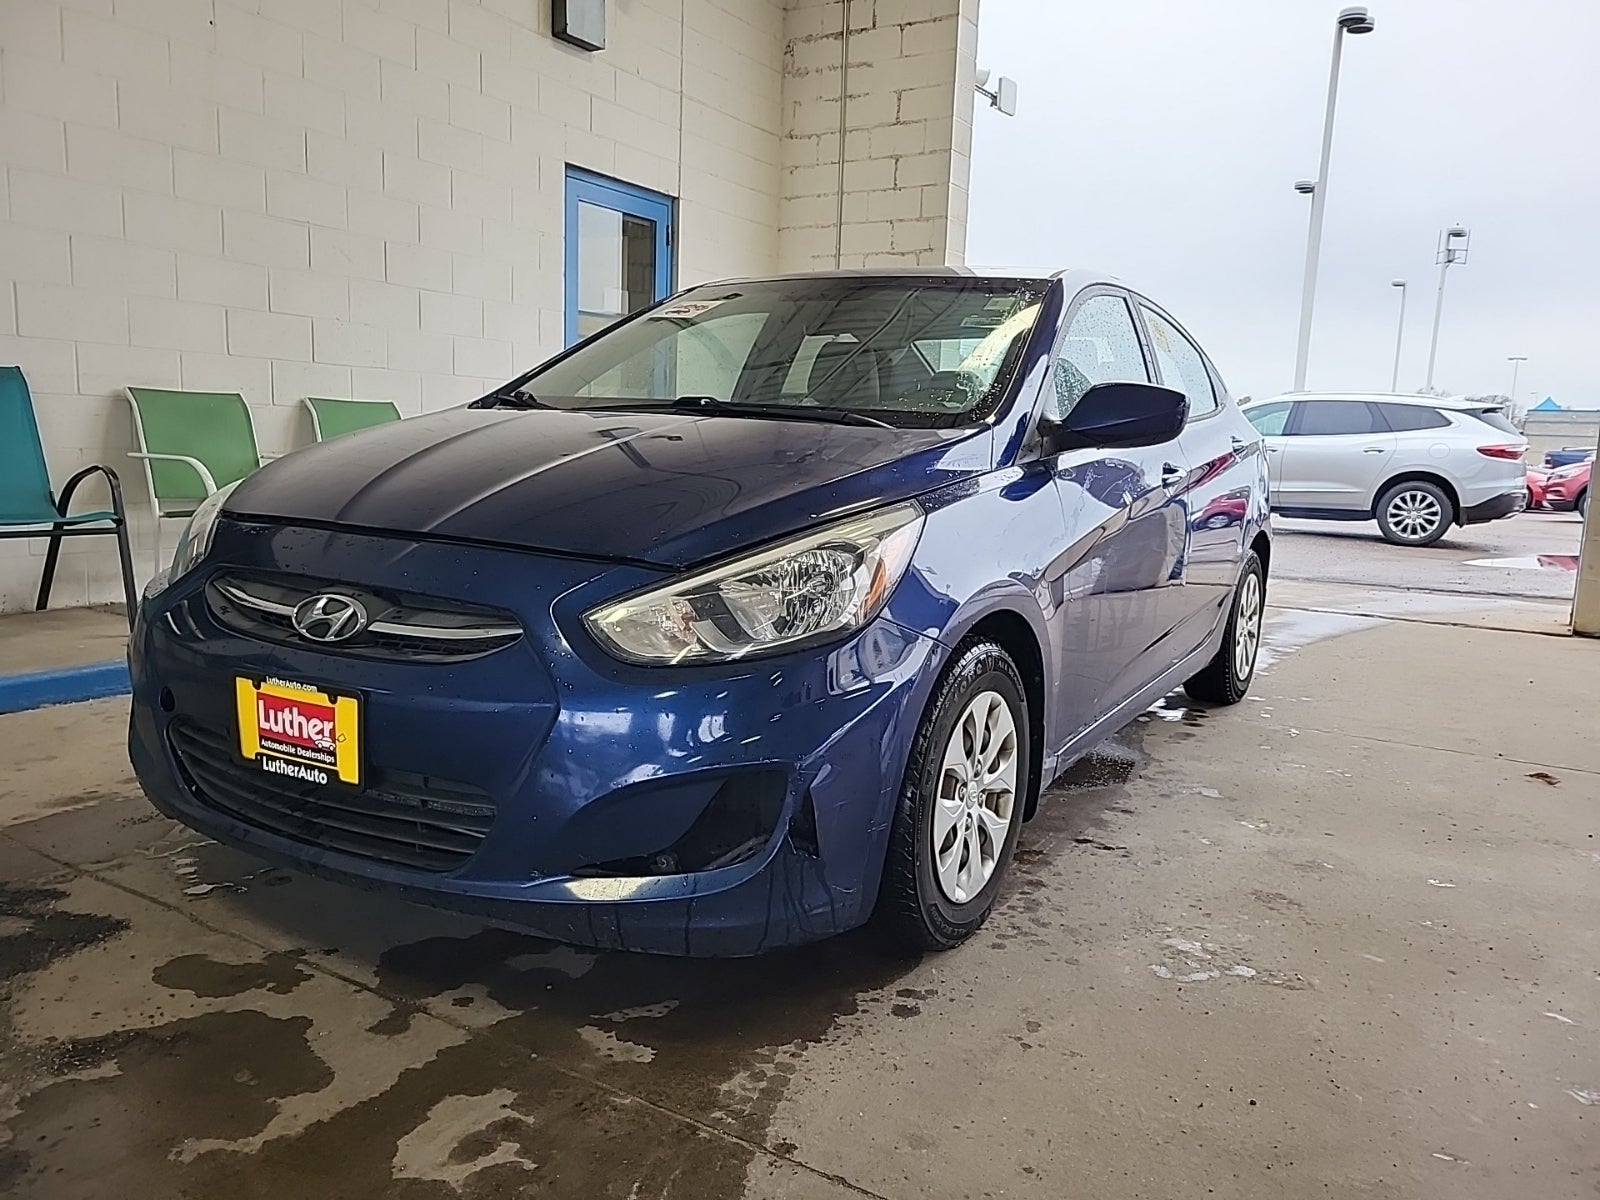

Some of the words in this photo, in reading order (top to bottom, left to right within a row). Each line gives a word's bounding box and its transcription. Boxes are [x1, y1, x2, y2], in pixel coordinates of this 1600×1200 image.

[266, 676, 317, 693] LutherAuto.com
[258, 699, 334, 740] Luther
[261, 738, 296, 754] Automobile
[297, 747, 335, 763] Dealerships
[262, 756, 328, 784] LutherAuto
